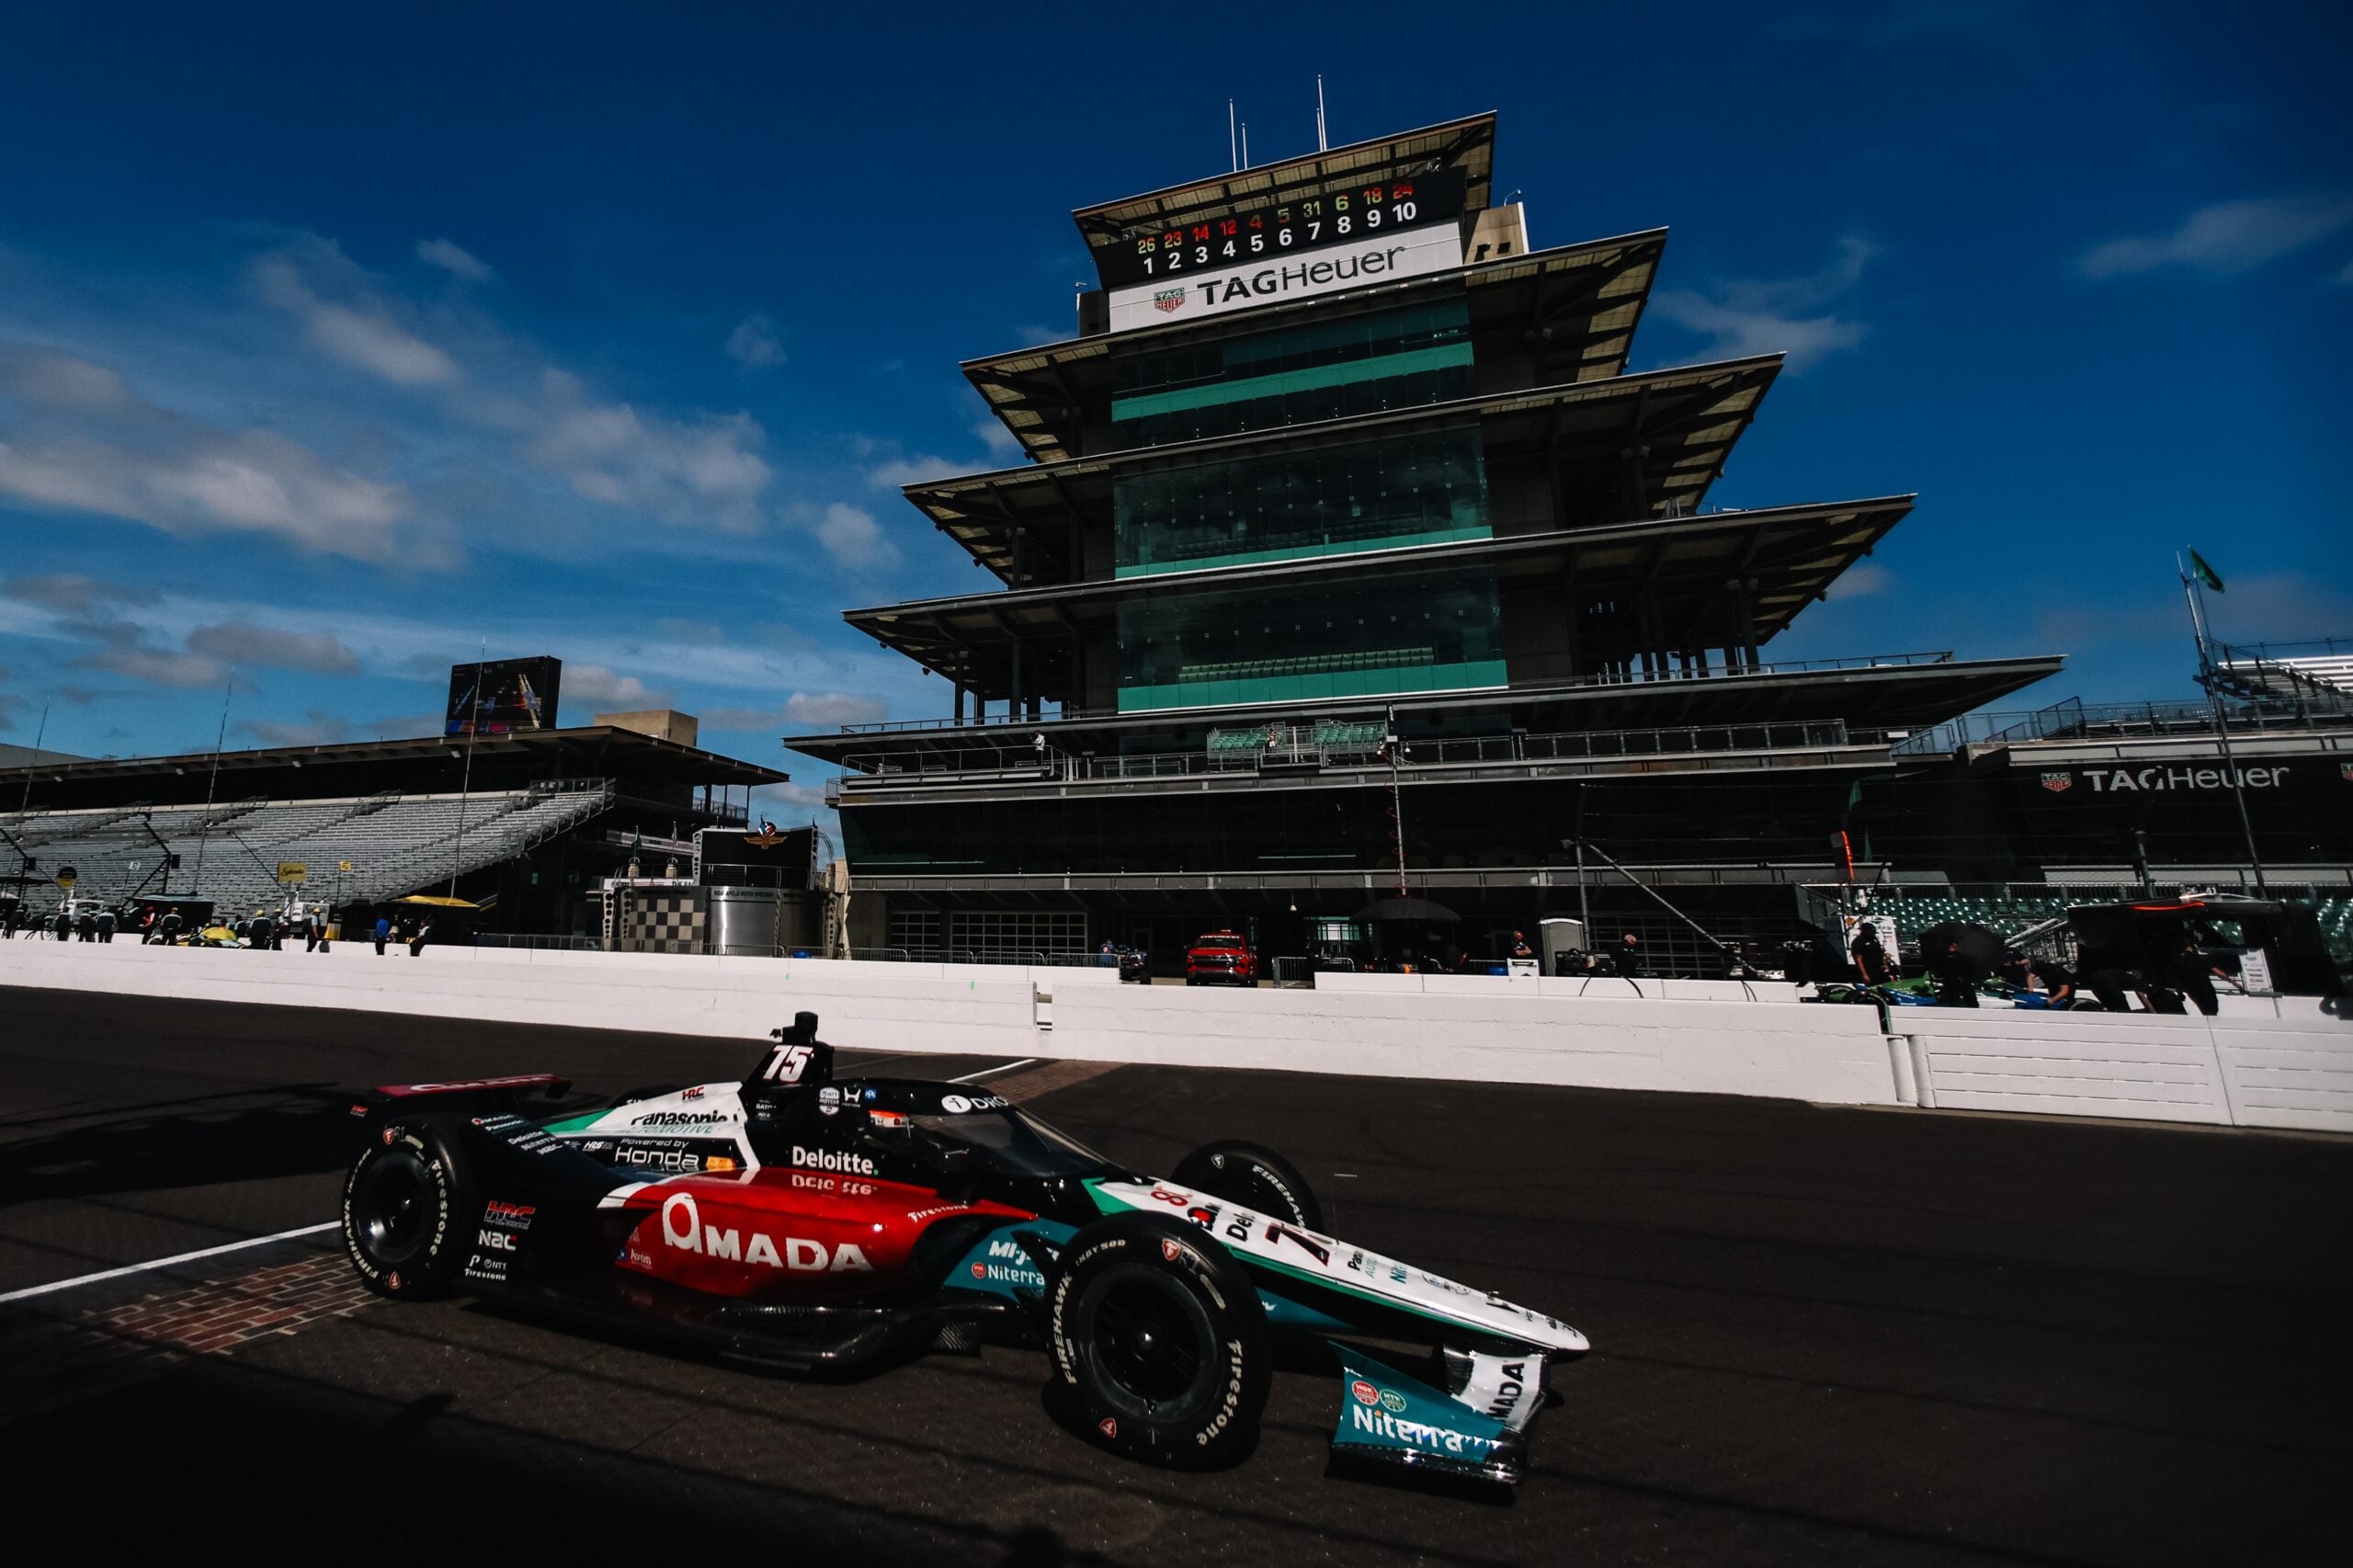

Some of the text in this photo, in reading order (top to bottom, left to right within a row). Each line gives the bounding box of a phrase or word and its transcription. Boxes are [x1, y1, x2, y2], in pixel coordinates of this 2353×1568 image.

[1138, 236, 1155, 255] 26
[1164, 230, 1183, 249] 23
[1192, 223, 1211, 243] 14
[1220, 218, 1238, 236] 12
[1249, 213, 1263, 229] 4
[1277, 207, 1290, 224] 5
[1302, 199, 1321, 219] 31
[1335, 193, 1349, 211] 6
[1143, 201, 1416, 274] 1 2 3 4 5 6 7 8 9 10
[1155, 289, 1183, 301] TAG
[1155, 296, 1186, 312] HEUER
[2044, 773, 2068, 781] TAG
[762, 1044, 814, 1083] 75
[681, 1086, 705, 1101] HRC
[620, 1137, 672, 1148] Powered
[673, 1139, 690, 1149] by
[615, 1146, 699, 1165] Honda
[1251, 1164, 1307, 1229] FIREHAW
[907, 1203, 970, 1223] Firestone
[464, 1267, 506, 1281] Firestone
[987, 1264, 1045, 1286] Niterra
[1052, 1271, 1078, 1385] FIREHAWK
[1196, 1338, 1244, 1447] Firestone
[1487, 1362, 1525, 1423] MADA
[1352, 1403, 1463, 1453] Niterra
